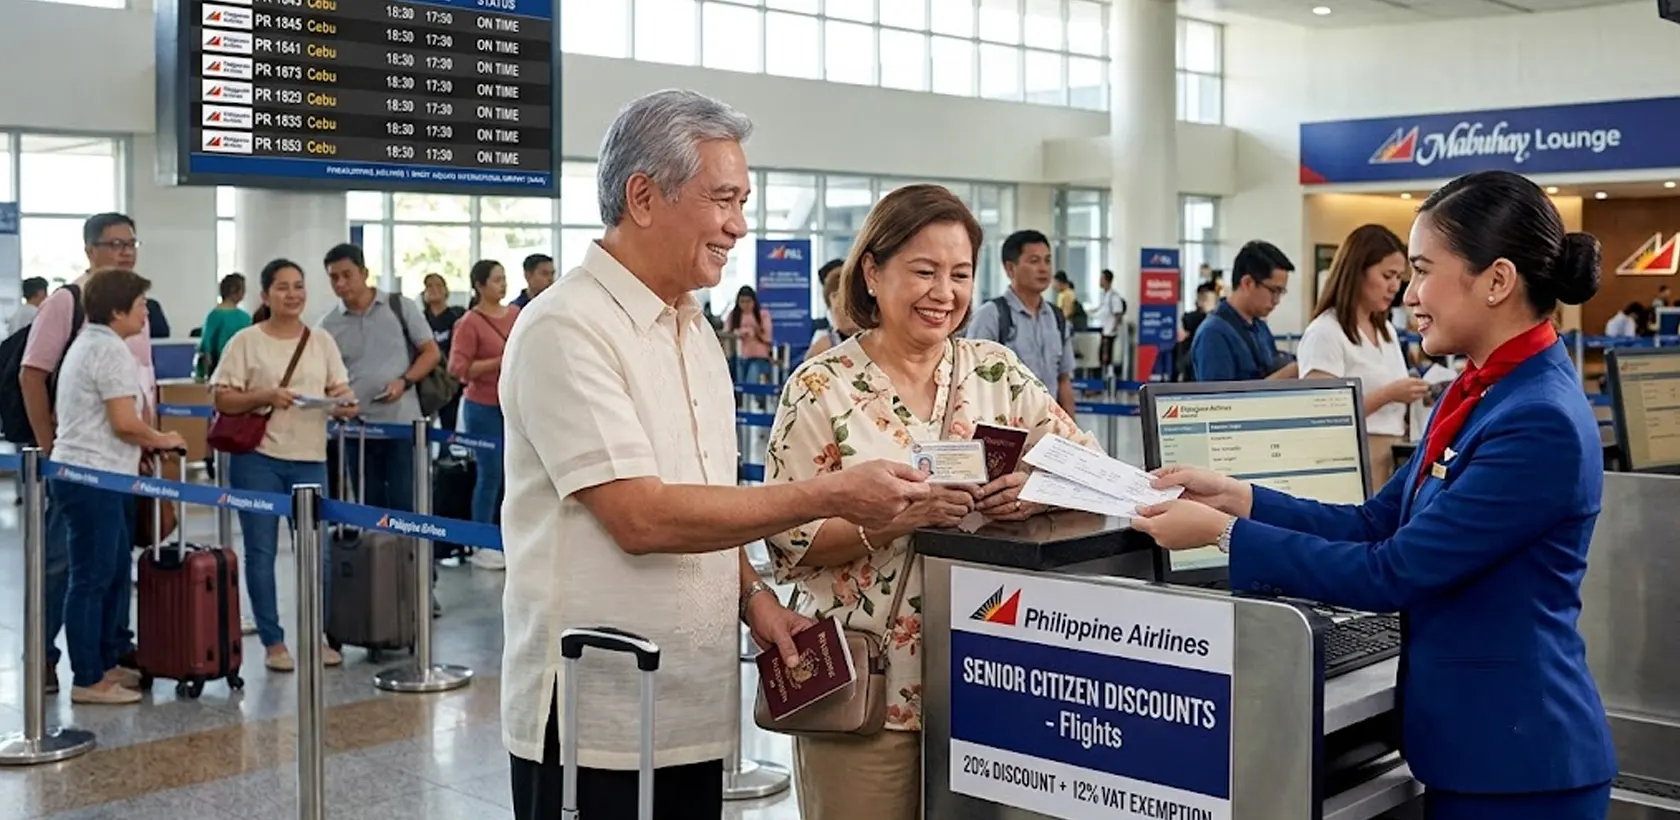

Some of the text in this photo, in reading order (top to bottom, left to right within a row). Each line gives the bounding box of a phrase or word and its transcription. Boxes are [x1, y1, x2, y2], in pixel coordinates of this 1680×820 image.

[256, 14, 271, 27] PR
[308, 20, 335, 33] Cebu
[477, 40, 492, 51] ON
[496, 41, 518, 53] TIME
[477, 17, 492, 29] ON
[495, 18, 519, 32] TIME
[255, 38, 272, 51] PR
[308, 44, 336, 58] Cebu
[477, 61, 492, 73] ON
[496, 63, 518, 76] TIME
[256, 63, 271, 76] PR
[308, 68, 336, 82] Cebu
[477, 84, 493, 96] ON
[496, 85, 518, 98] TIME
[255, 88, 271, 101] PR
[308, 93, 336, 106] Cebu
[477, 106, 492, 118] ON
[496, 108, 518, 121] TIME
[255, 113, 272, 125] PR
[308, 116, 336, 129] Cebu
[477, 129, 492, 140] ON
[496, 130, 518, 142] TIME
[1416, 121, 1621, 166] Mabuhay Lounge
[255, 138, 272, 150] PR
[307, 141, 336, 154] Cebu
[477, 151, 492, 162] ON
[496, 152, 519, 164] TIME
[1024, 607, 1210, 656] Philippine Airlines
[963, 656, 1217, 730] SENIOR CITIZEN DISCOUNTS
[1059, 710, 1123, 749] Flights
[963, 755, 990, 778] 20%
[993, 761, 1056, 794] DISCOUNT
[1073, 780, 1100, 804] 12%
[1101, 786, 1126, 811] VAT
[1130, 793, 1213, 820] EXEMPTION
